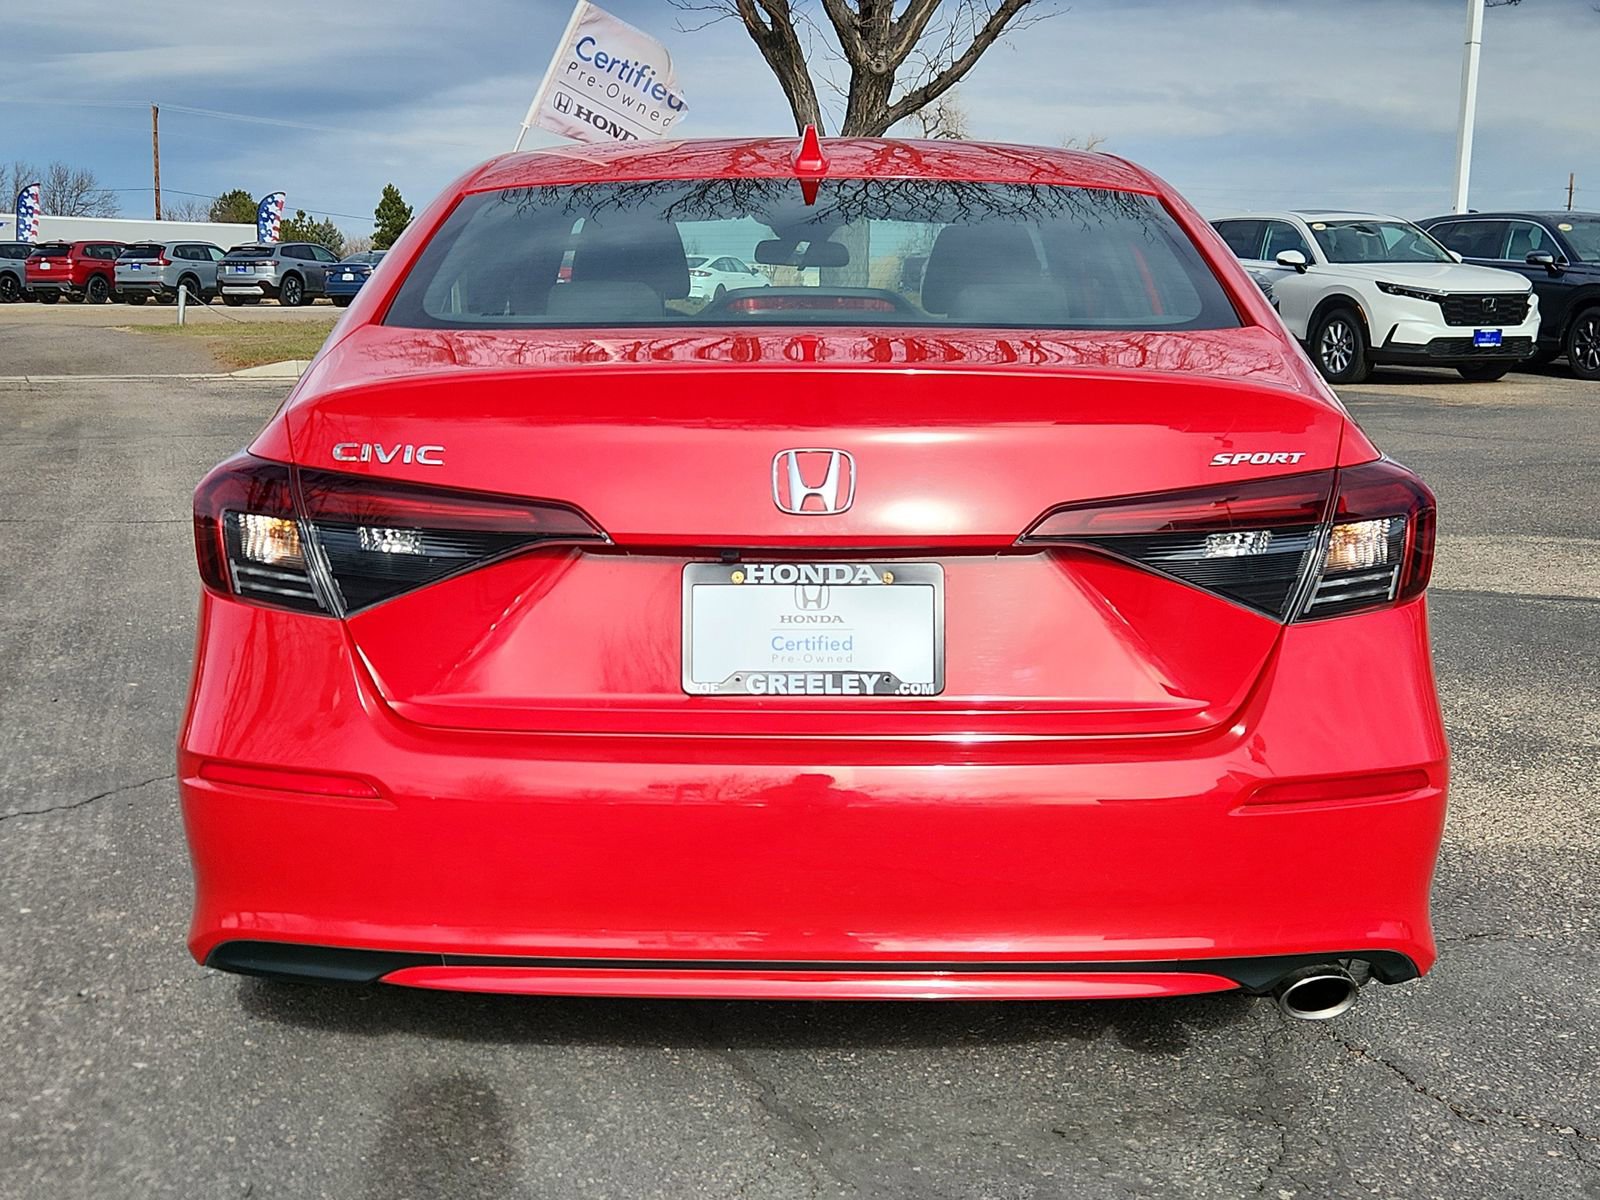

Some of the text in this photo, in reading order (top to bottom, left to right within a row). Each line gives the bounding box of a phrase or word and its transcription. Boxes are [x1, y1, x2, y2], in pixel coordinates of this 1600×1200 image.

[566, 61, 676, 127] Pre-Owned
[574, 103, 639, 141] HOND
[332, 442, 446, 465] CIVIC
[1209, 451, 1307, 467] SPORT
[743, 564, 882, 584] HONDA
[779, 615, 845, 623] HONDA
[771, 635, 853, 651] Certified
[771, 653, 853, 663] Pre-Owned
[745, 673, 880, 695] GREELEY
[894, 683, 935, 695] .COM
